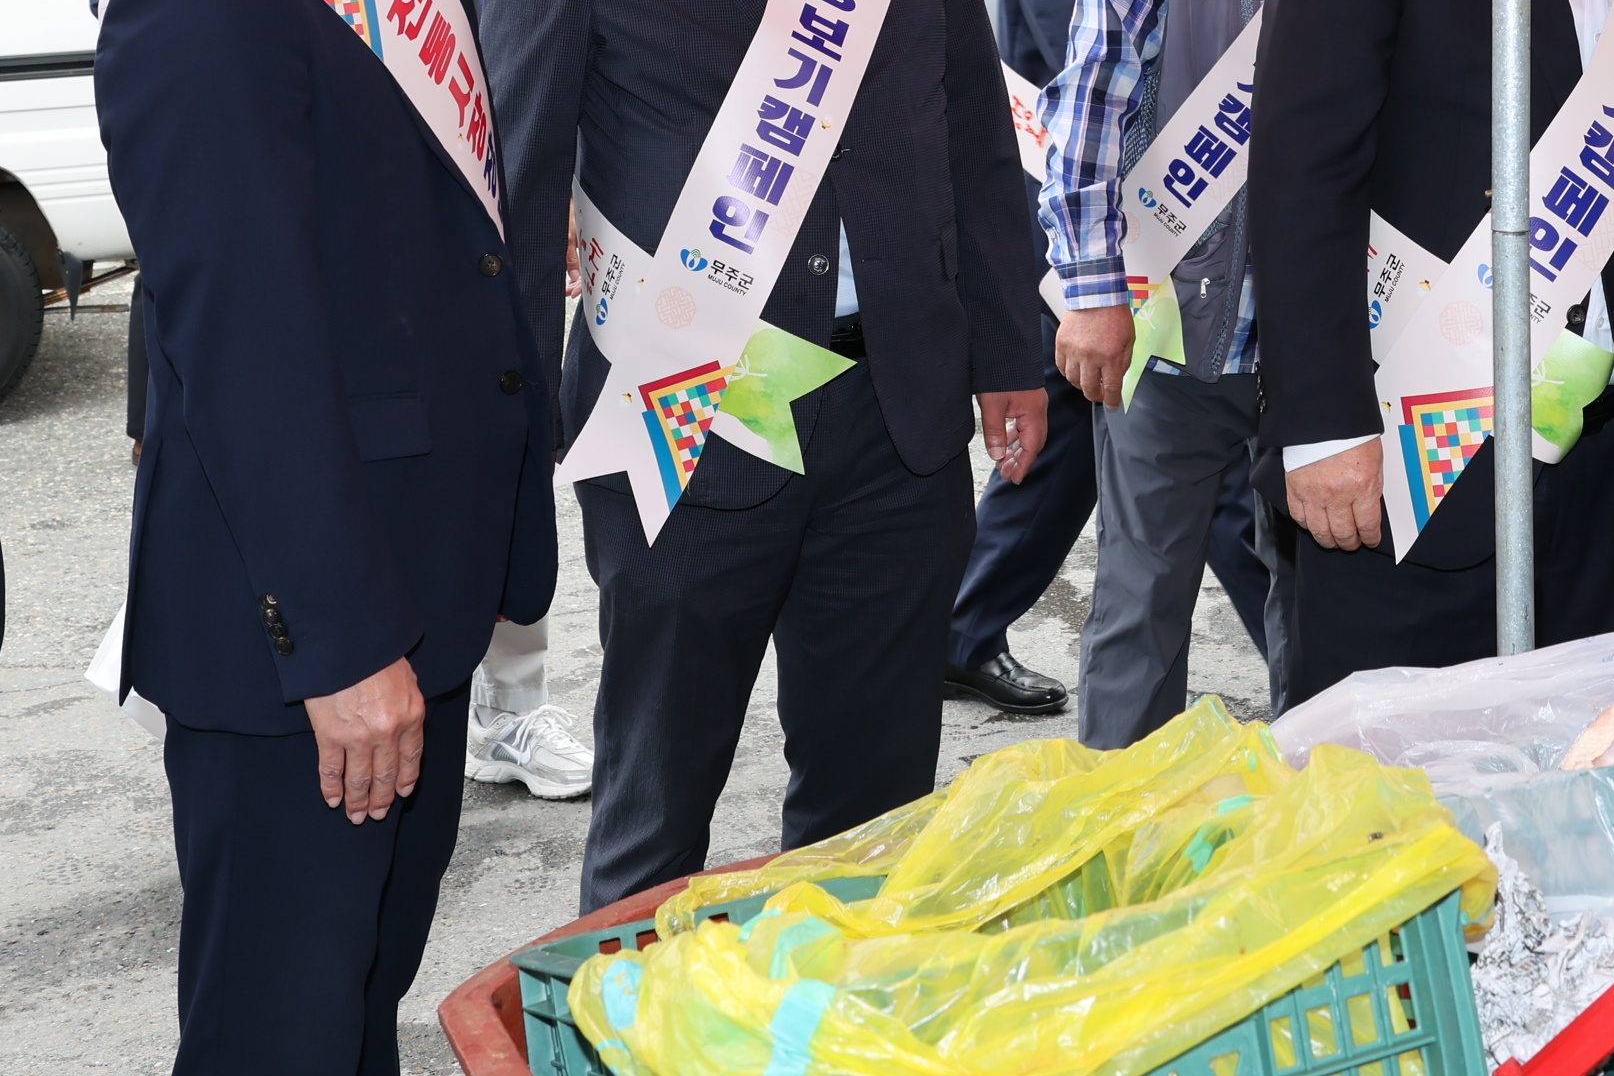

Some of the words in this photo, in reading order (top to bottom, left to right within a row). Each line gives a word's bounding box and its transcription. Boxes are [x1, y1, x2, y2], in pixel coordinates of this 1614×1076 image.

[1156, 202, 1188, 235] 무주군
[1163, 220, 1180, 238] COUNTY
[601, 253, 624, 296] 무주군
[609, 283, 619, 301] MUJU
[614, 261, 626, 285] COUNTY
[707, 274, 724, 287] MUJU
[722, 280, 748, 297] COUNTY
[710, 258, 755, 291] 무주군
[1373, 253, 1401, 298] 무주군
[1384, 286, 1395, 303] MUJU
[1391, 262, 1406, 287] COUNTY
